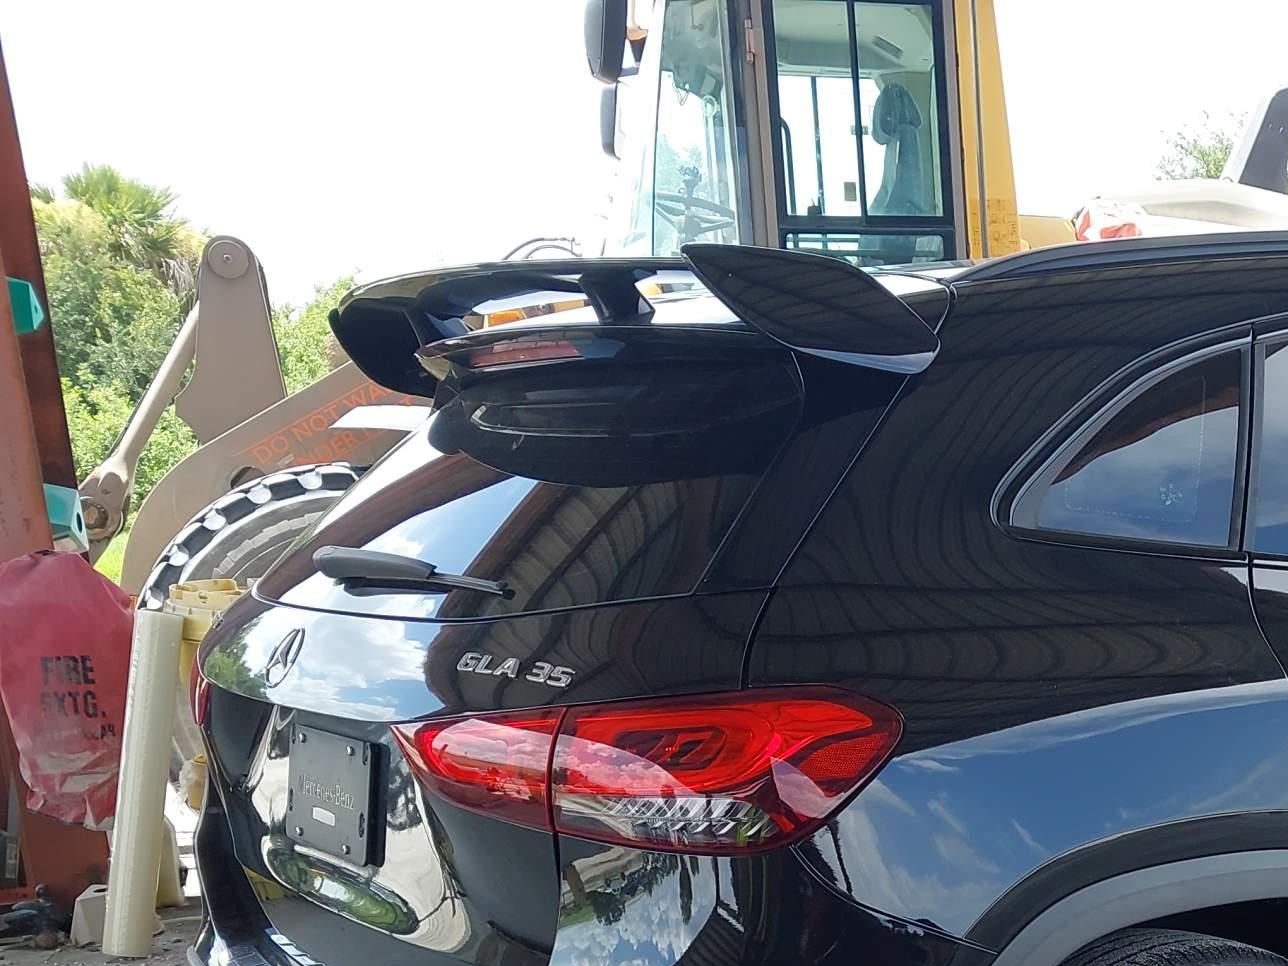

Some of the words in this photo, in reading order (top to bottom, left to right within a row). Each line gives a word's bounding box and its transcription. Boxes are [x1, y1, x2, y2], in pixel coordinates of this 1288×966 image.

[253, 436, 290, 465] DO
[293, 404, 343, 440] NOT
[343, 382, 394, 407] WA
[40, 655, 96, 685] FIRE
[456, 651, 520, 678] GLA
[525, 661, 576, 687] 35
